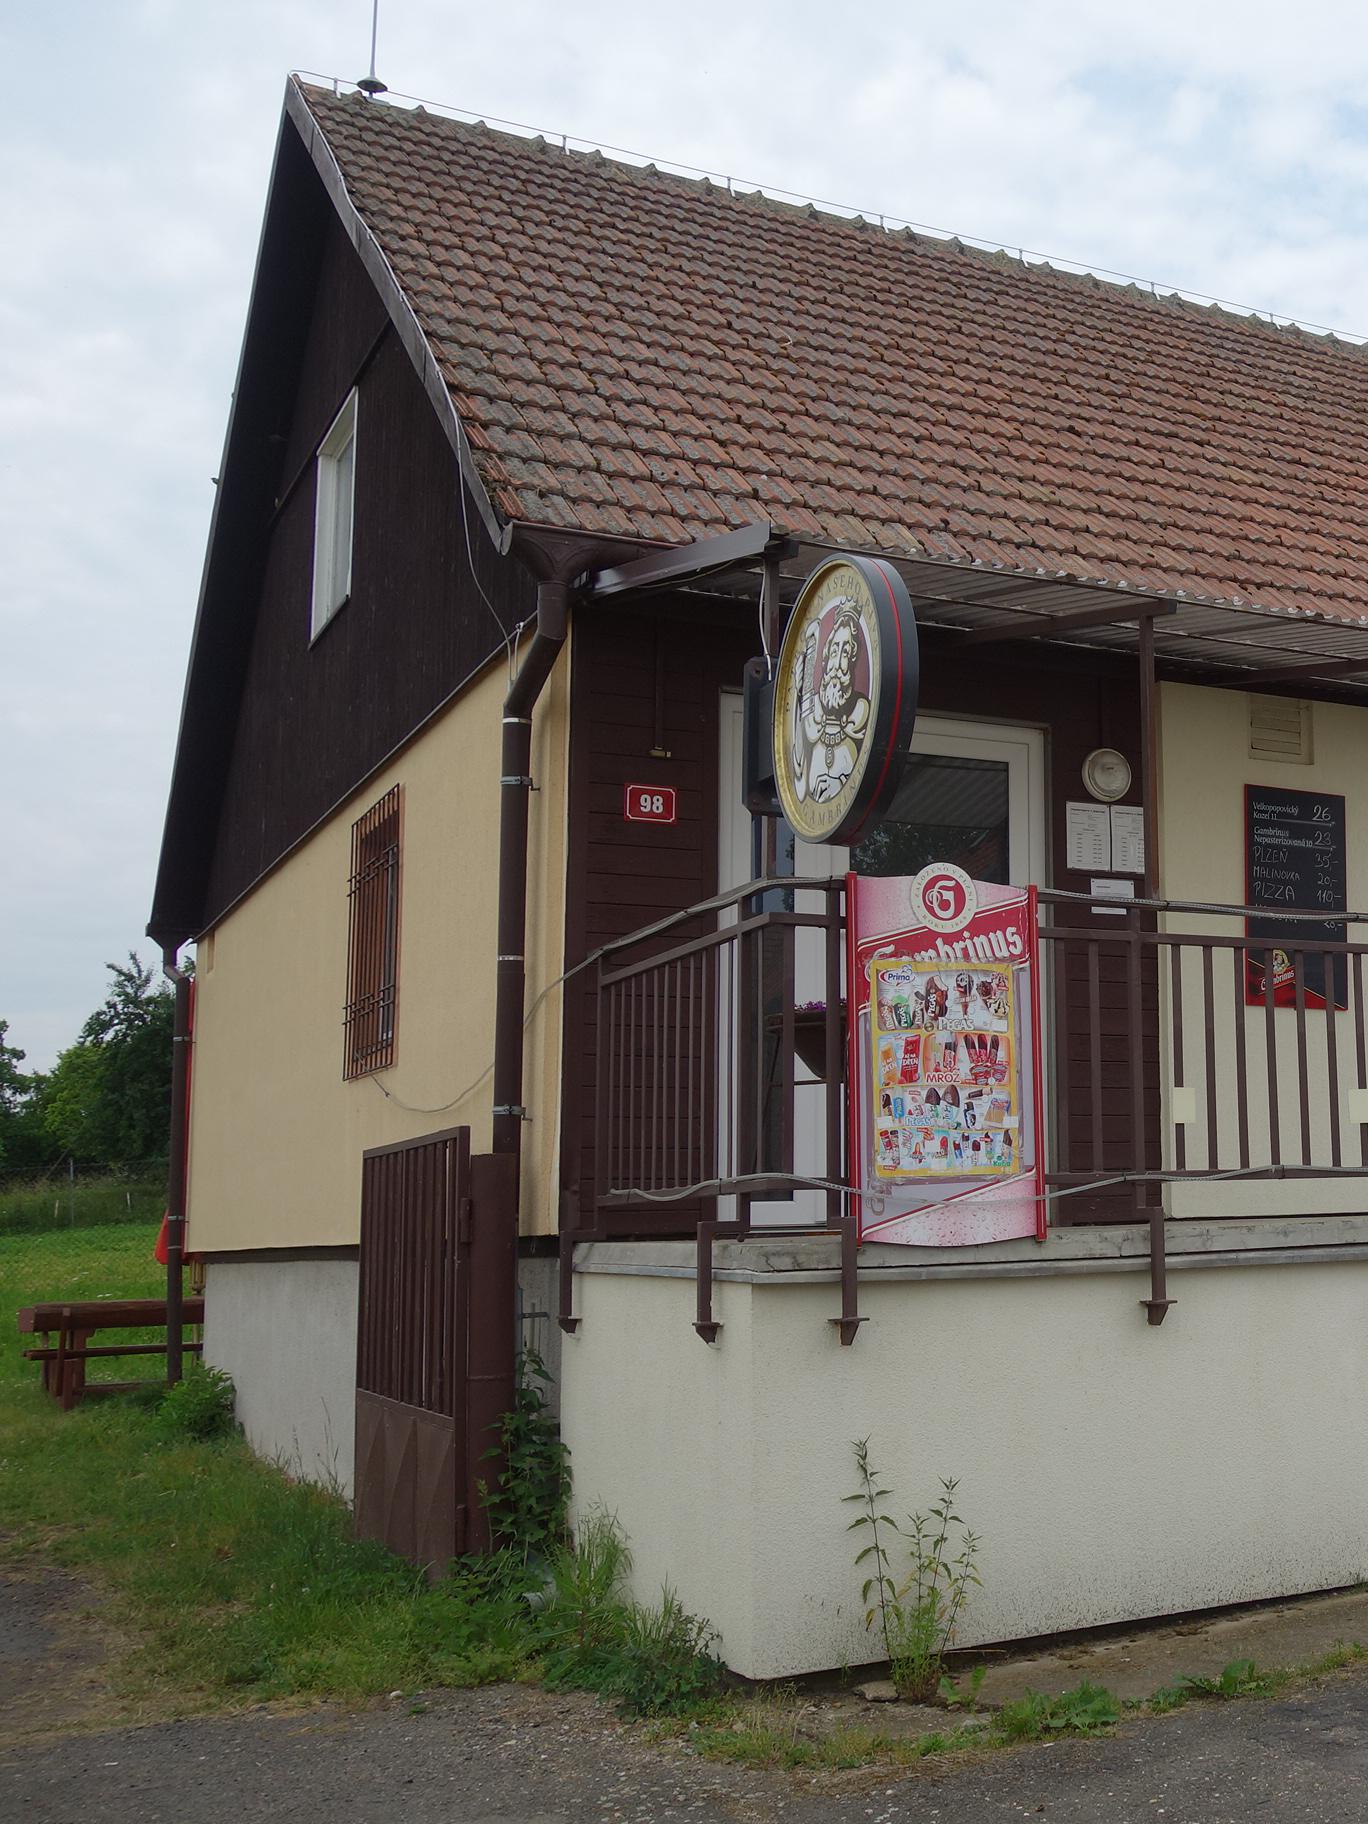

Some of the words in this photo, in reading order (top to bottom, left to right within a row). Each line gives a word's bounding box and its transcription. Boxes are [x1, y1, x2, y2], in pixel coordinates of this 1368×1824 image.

[640, 794, 663, 813] 98
[1253, 811, 1270, 820] Kozel
[1254, 826, 1289, 837] Gambrinus
[1253, 845, 1289, 864] PLZEŇ
[1253, 881, 1296, 901] PIZZA
[865, 926, 1024, 984] Gmbrinus
[887, 973, 911, 981] Prima
